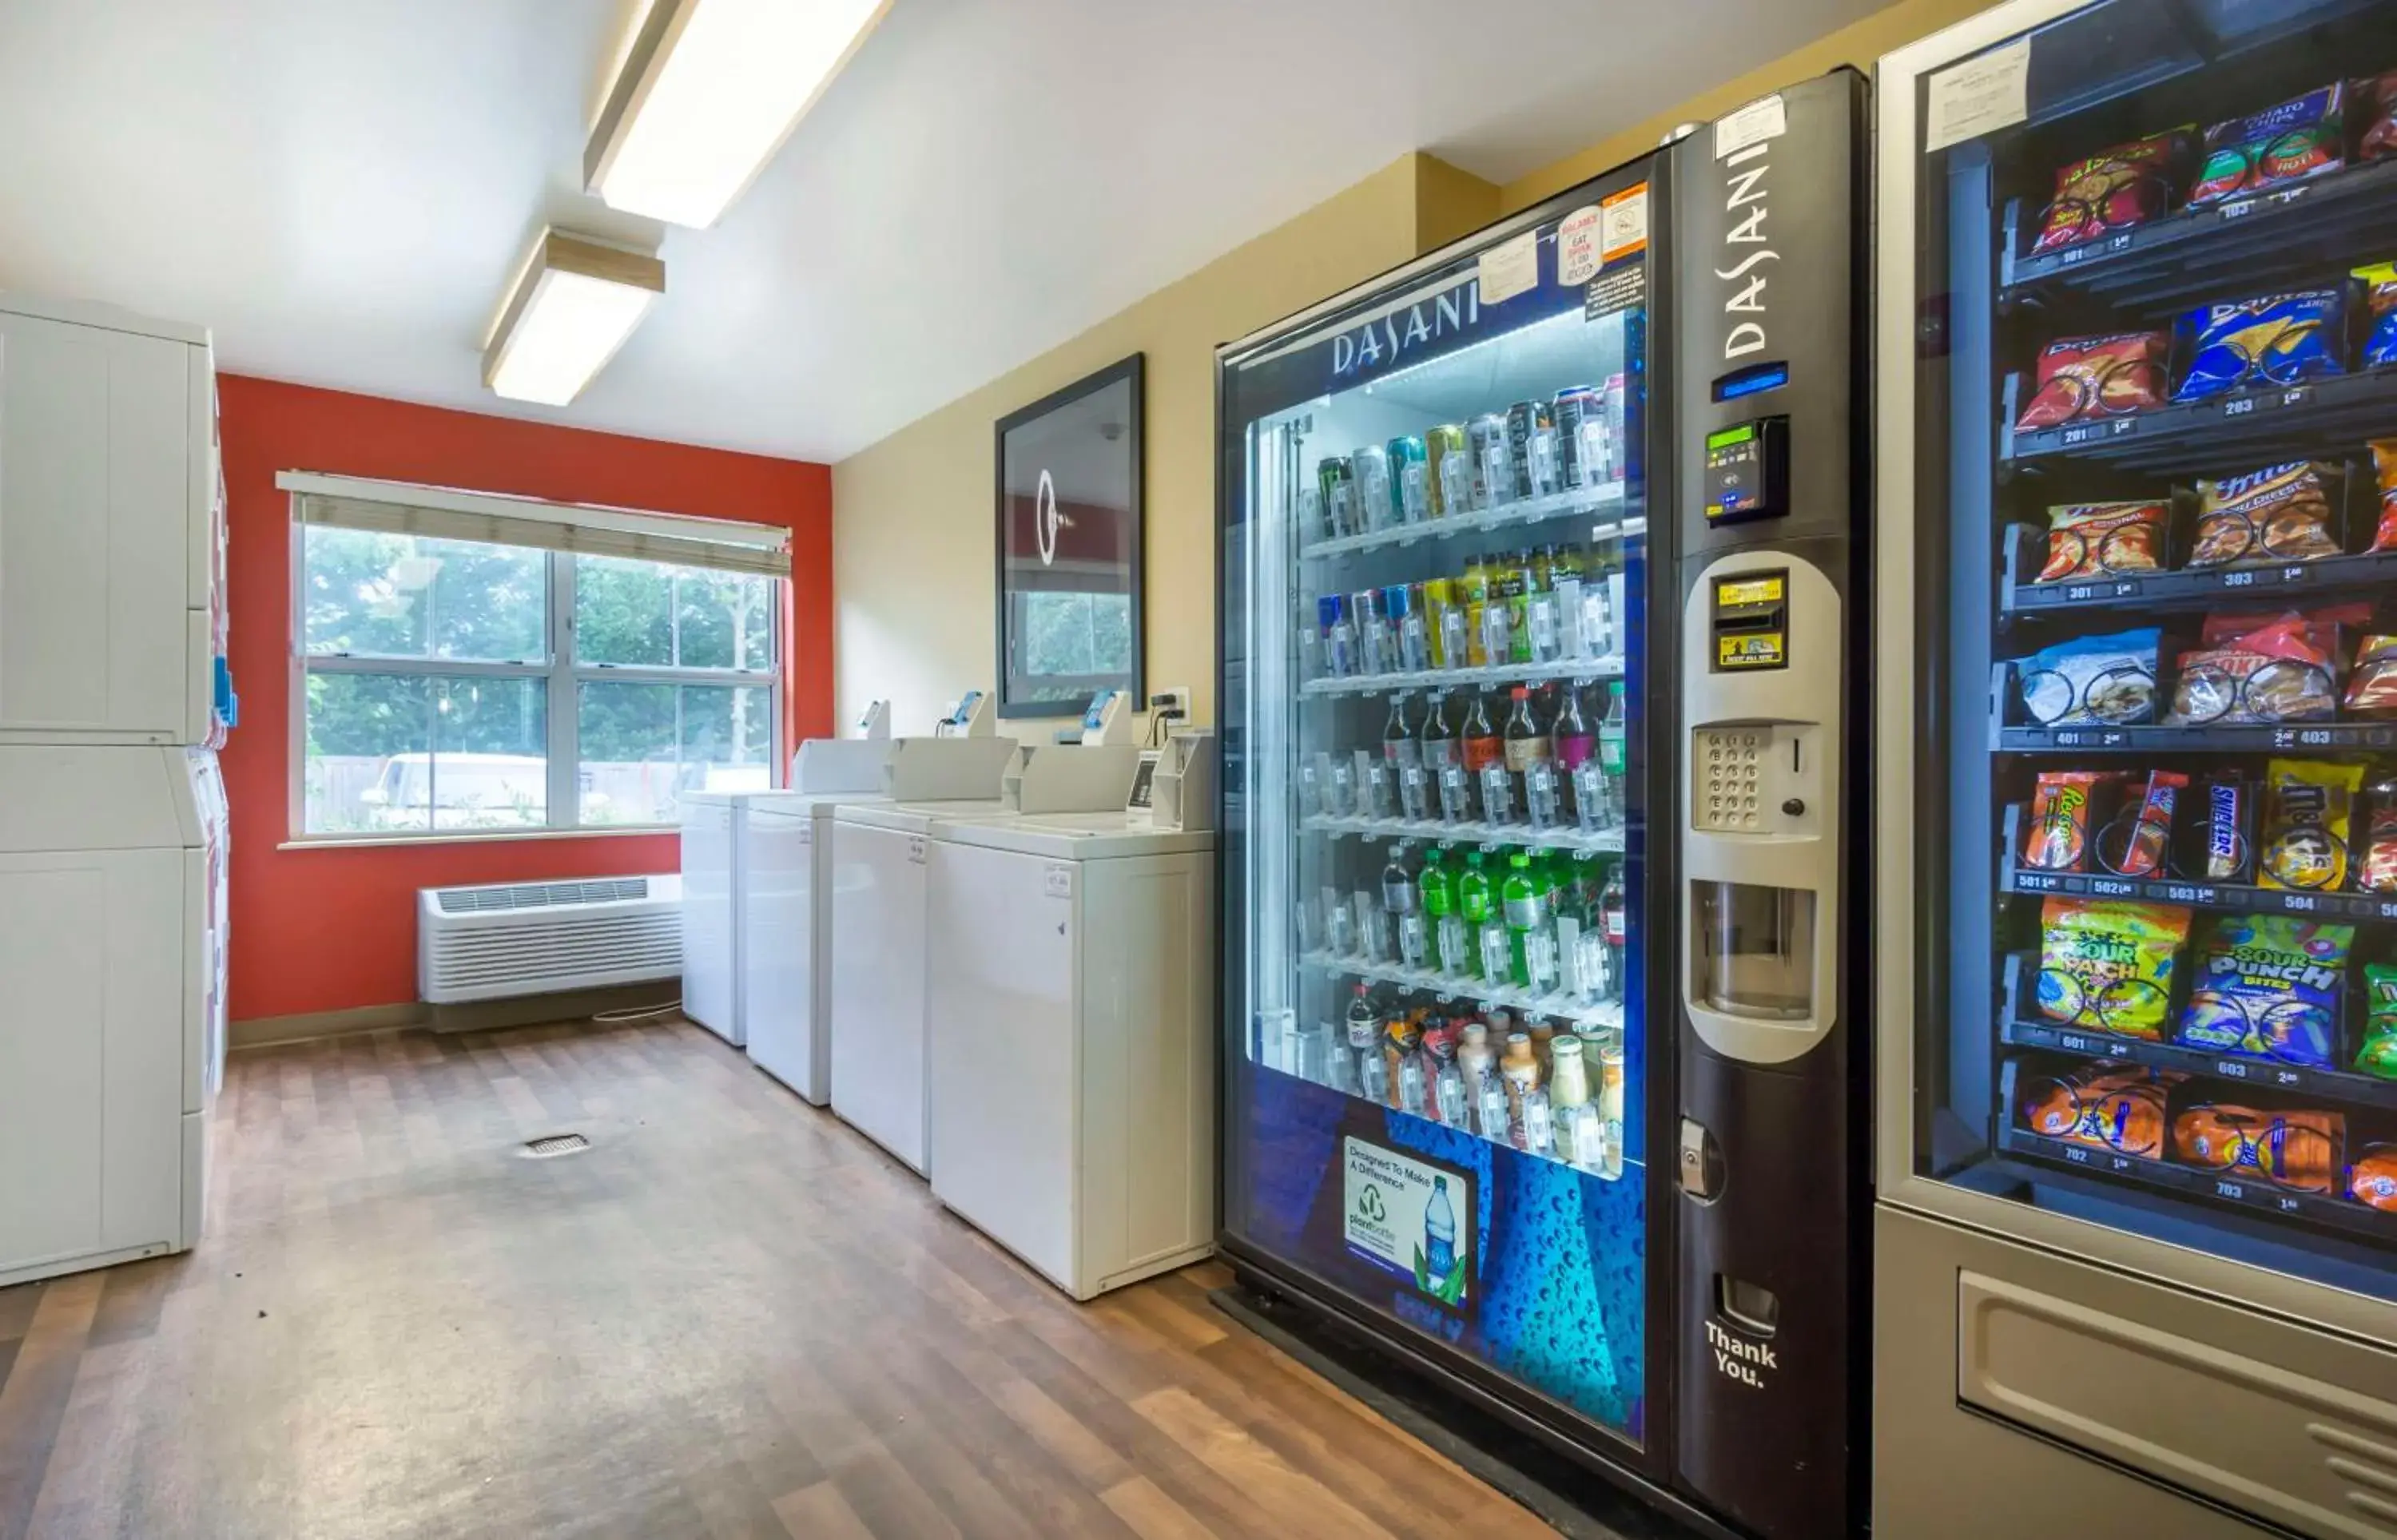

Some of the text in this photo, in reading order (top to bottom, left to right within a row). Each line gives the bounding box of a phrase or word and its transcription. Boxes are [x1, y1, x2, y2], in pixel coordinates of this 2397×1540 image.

[1715, 143, 1781, 359] DASANI
[1334, 281, 1477, 375] DASANI
[2225, 399, 2252, 415] 203
[2065, 430, 2086, 443] 201
[2224, 572, 2252, 586] 303
[2070, 587, 2091, 598] 301
[2057, 732, 2078, 744] 401
[2300, 731, 2331, 744] 403
[2212, 787, 2235, 855] SNICKERS
[2019, 875, 2041, 887] 501
[2094, 881, 2116, 894] 502
[2168, 887, 2194, 900] 503
[2285, 895, 2314, 911] 504
[2235, 946, 2309, 967] SOUR
[2065, 959, 2138, 980] PATCH
[2209, 956, 2337, 991] PUNCH
[2244, 976, 2292, 990] BITES
[2062, 1037, 2085, 1050] 601
[2218, 1062, 2246, 1078] 603
[2065, 1147, 2087, 1162] 702
[1350, 1146, 1431, 1188] Designed To Make
[1350, 1161, 1405, 1191] A Difference
[2216, 1181, 2242, 1198] 703
[1704, 1320, 1777, 1369] Thank
[1715, 1348, 1764, 1388] You.
